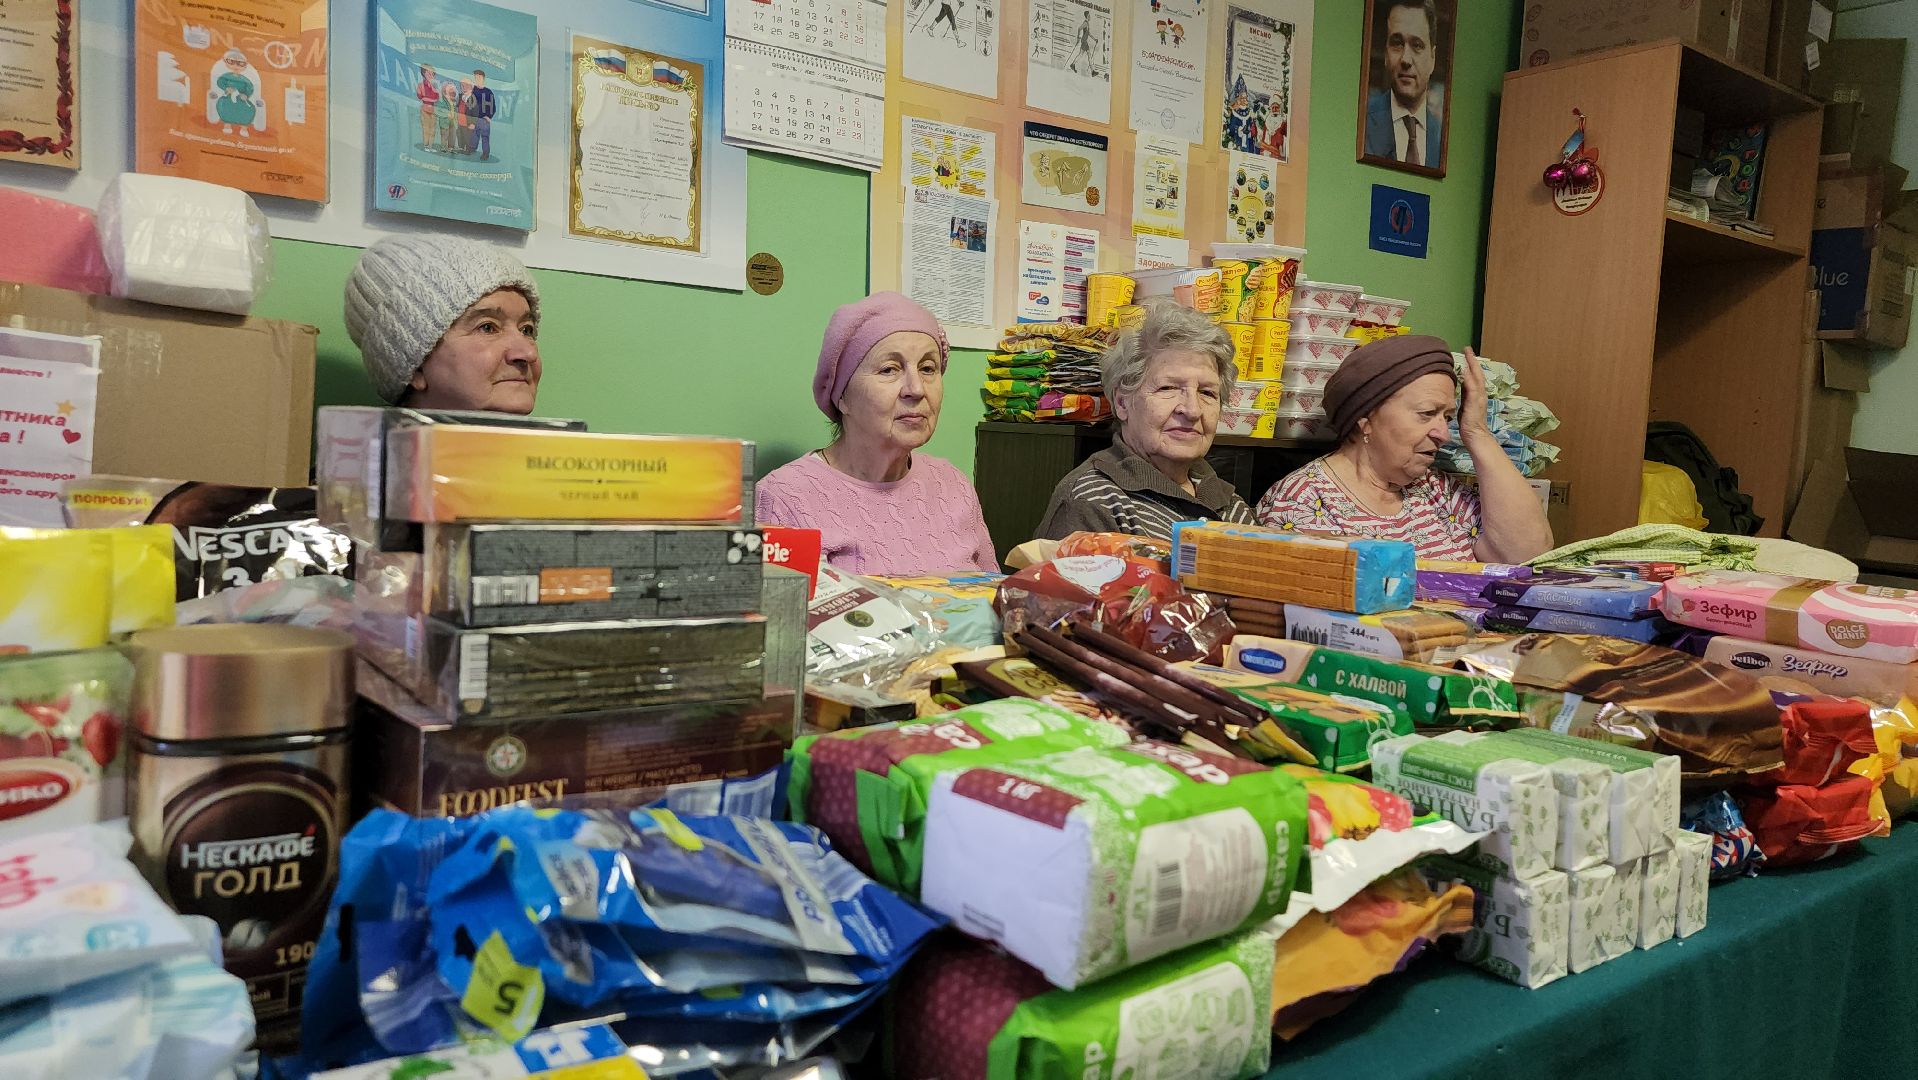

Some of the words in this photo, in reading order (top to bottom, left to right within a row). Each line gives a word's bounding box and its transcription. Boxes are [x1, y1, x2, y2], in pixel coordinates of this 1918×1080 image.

[526, 456, 667, 473] ВЫСОКОГОРНЫЙ
[763, 543, 790, 562] Pie
[1700, 600, 1757, 621] Зефир
[1829, 623, 1865, 635] DOLCE
[1833, 631, 1867, 641] MANIA
[1729, 654, 1772, 668] Delibon
[1782, 654, 1848, 679] Зефир
[1335, 669, 1346, 685] С
[1348, 671, 1407, 699] ХАЛВОЙ
[193, 860, 303, 898] ГОЛД
